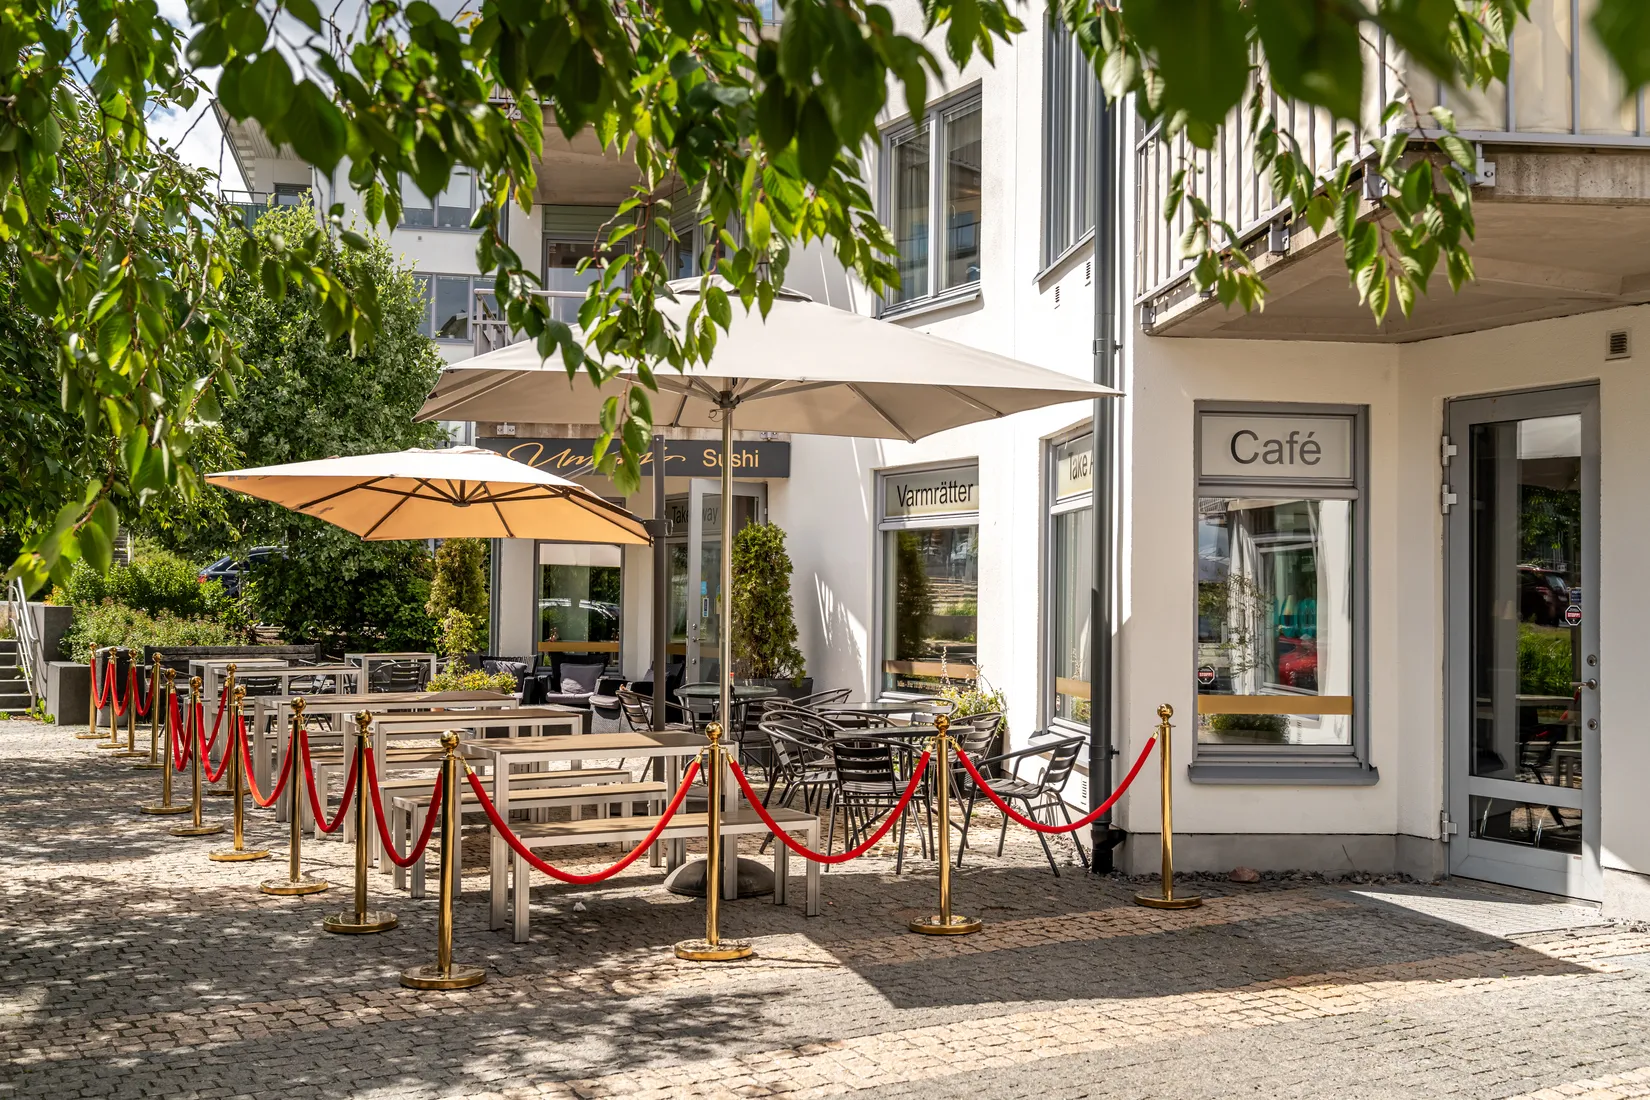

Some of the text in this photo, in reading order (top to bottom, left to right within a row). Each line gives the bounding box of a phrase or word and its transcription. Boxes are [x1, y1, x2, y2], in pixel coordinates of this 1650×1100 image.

[1230, 429, 1322, 466] Café
[1068, 451, 1088, 480] Take
[896, 480, 974, 507] Varmrätter
